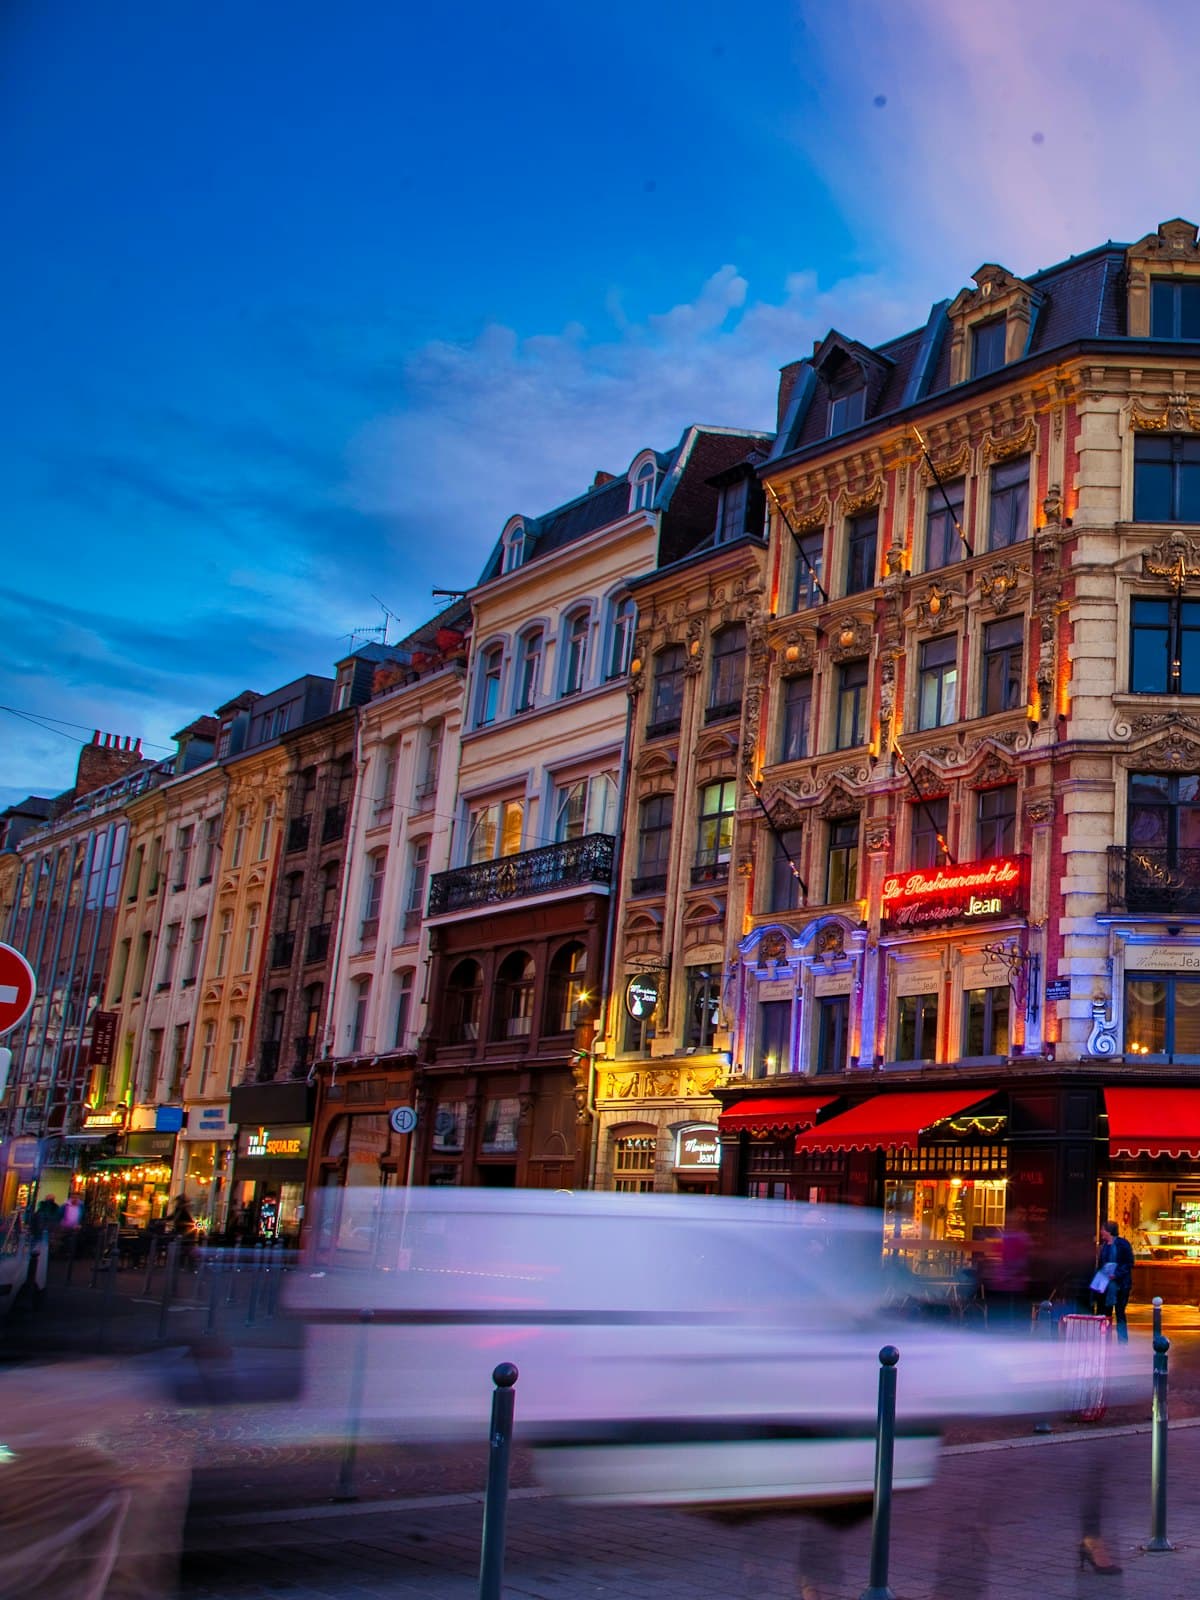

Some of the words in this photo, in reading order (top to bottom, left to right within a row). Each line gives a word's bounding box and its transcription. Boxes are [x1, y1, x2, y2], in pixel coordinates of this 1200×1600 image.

[882, 878, 903, 899] Le
[904, 865, 995, 896] Restaurant
[995, 861, 1018, 881] de
[964, 896, 1002, 916] Jean
[642, 994, 656, 1003] Jean
[266, 1140, 300, 1155] SQUARE
[697, 1152, 713, 1164] Jean
